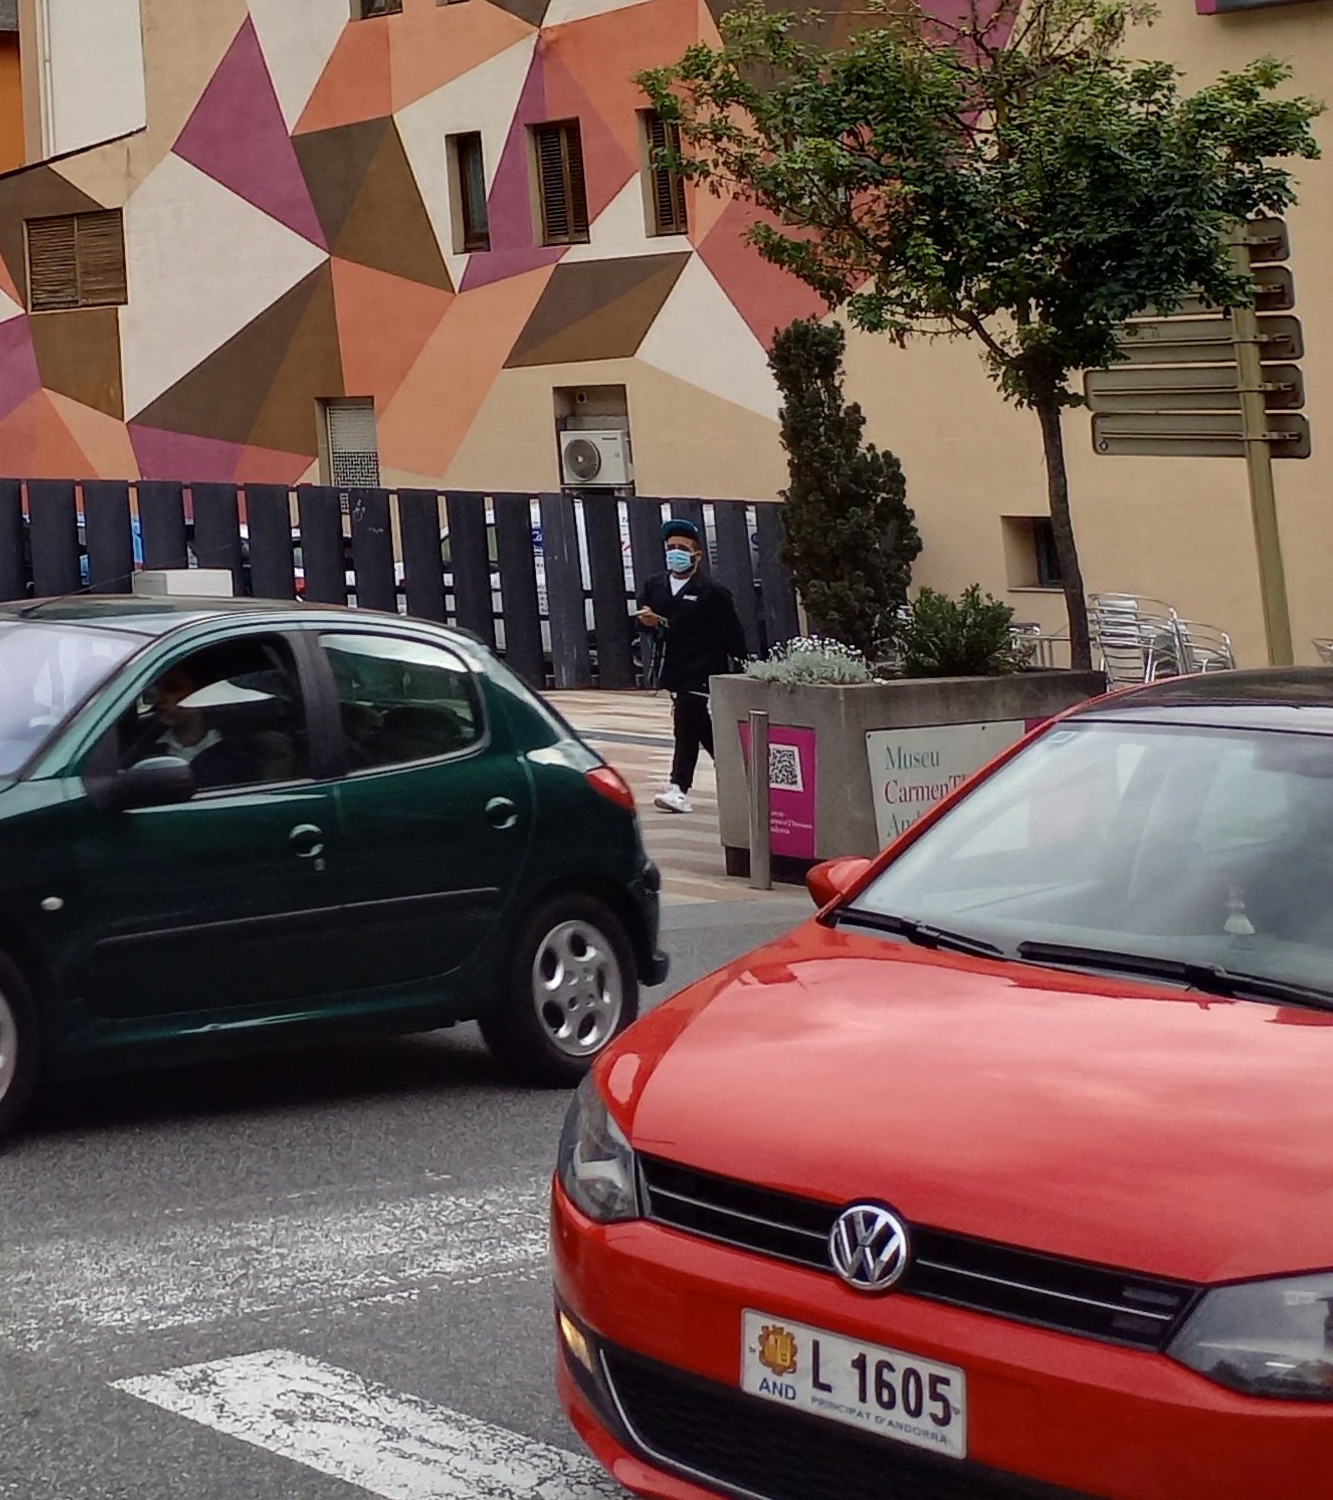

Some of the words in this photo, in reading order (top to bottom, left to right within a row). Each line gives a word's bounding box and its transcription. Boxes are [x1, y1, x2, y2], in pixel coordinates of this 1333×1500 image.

[885, 745, 940, 770] Museu
[884, 774, 966, 804] CarmenT
[758, 1376, 797, 1402] AND
[850, 1351, 952, 1428] 1605
[810, 1395, 872, 1421] PRINCIPAT
[874, 1414, 949, 1446] D'ANDORRA
